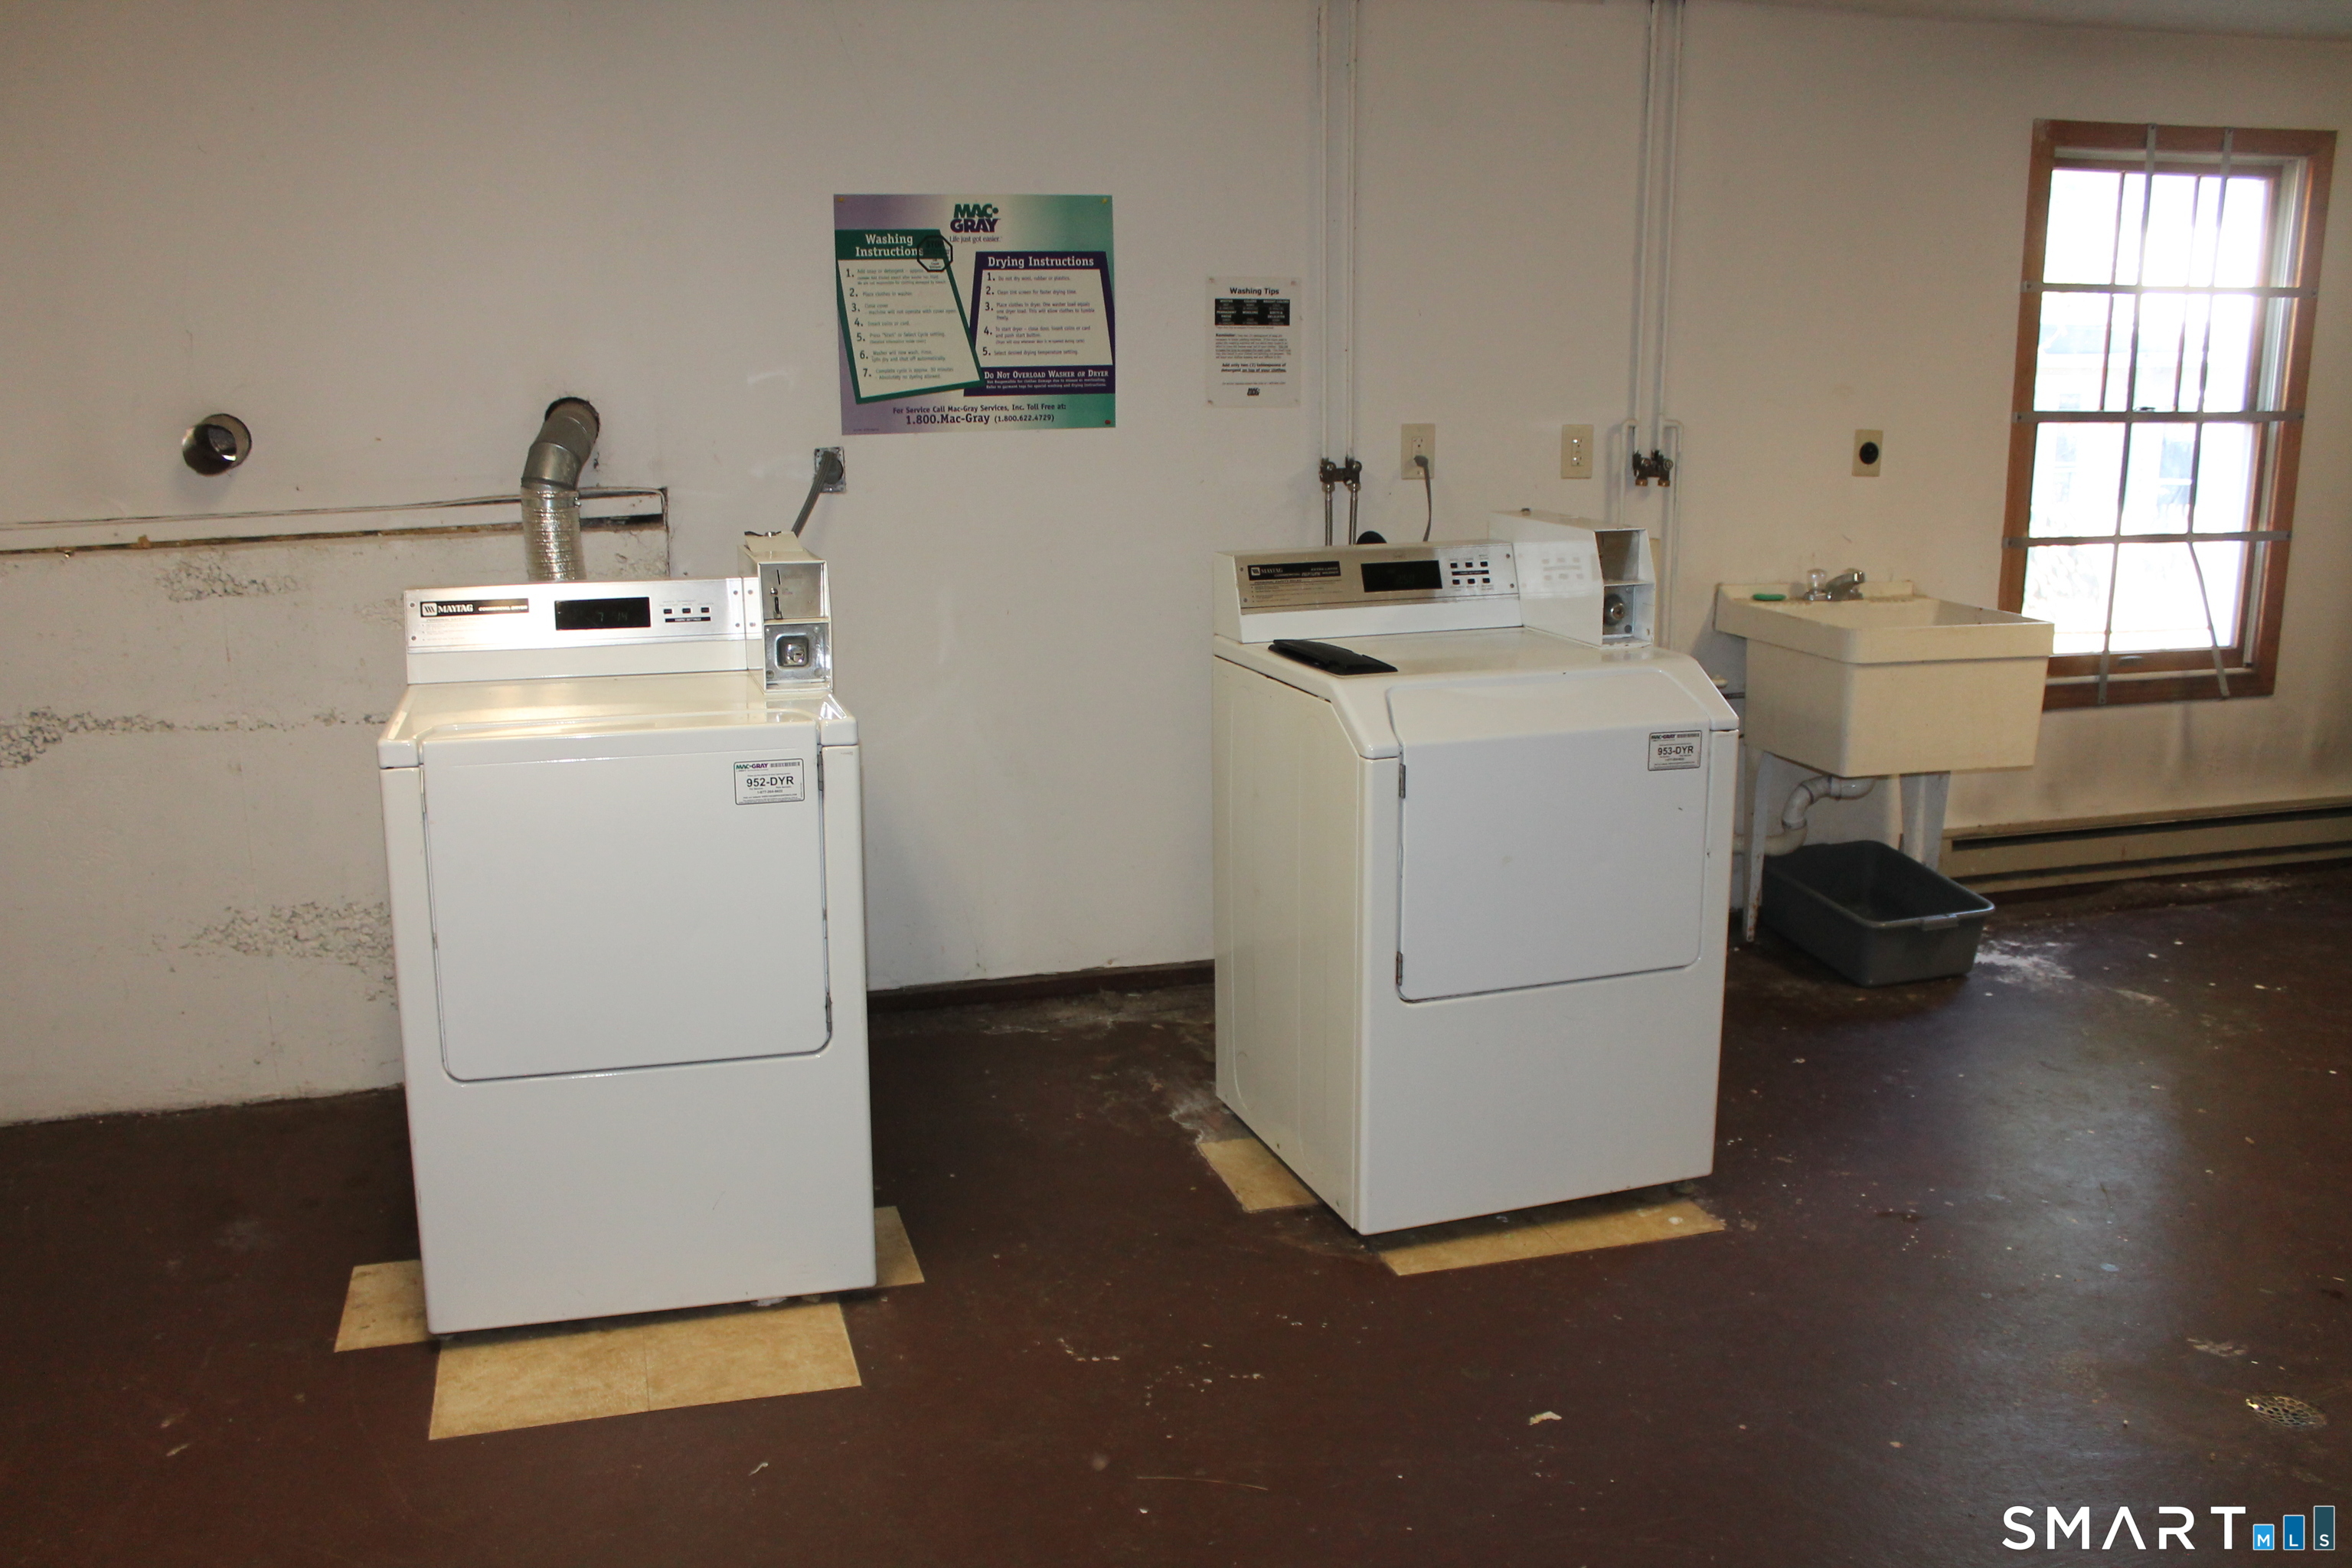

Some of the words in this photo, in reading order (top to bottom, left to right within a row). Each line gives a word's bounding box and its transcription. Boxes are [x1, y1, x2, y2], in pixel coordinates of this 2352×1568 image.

[951, 219, 998, 232] GRAY
[865, 234, 913, 245] Washing
[856, 247, 923, 257] Instructions
[988, 256, 1024, 268] Drying
[1029, 256, 1094, 266] Instructions
[846, 269, 854, 278] 1.
[988, 272, 995, 281] 1.
[849, 288, 858, 297] 2.
[986, 286, 994, 295] 2.
[1230, 287, 1262, 296] Washing
[851, 303, 860, 312] 3.
[985, 302, 993, 311] 3.
[854, 318, 863, 327] 4.
[983, 326, 992, 335] 4.
[857, 332, 866, 341] 5.
[859, 350, 868, 359] 6.
[983, 346, 991, 356] 5.
[863, 368, 871, 377] 7.
[948, 405, 977, 414] Mac-Gray
[980, 404, 1009, 412] Services,
[906, 413, 990, 425] 1.800.Mac-Gray
[995, 414, 1055, 424] (1.800.622.4729)
[438, 604, 474, 613] MAYTAG
[1658, 746, 1694, 755] 953-DYR
[746, 776, 794, 787] 952-DYR
